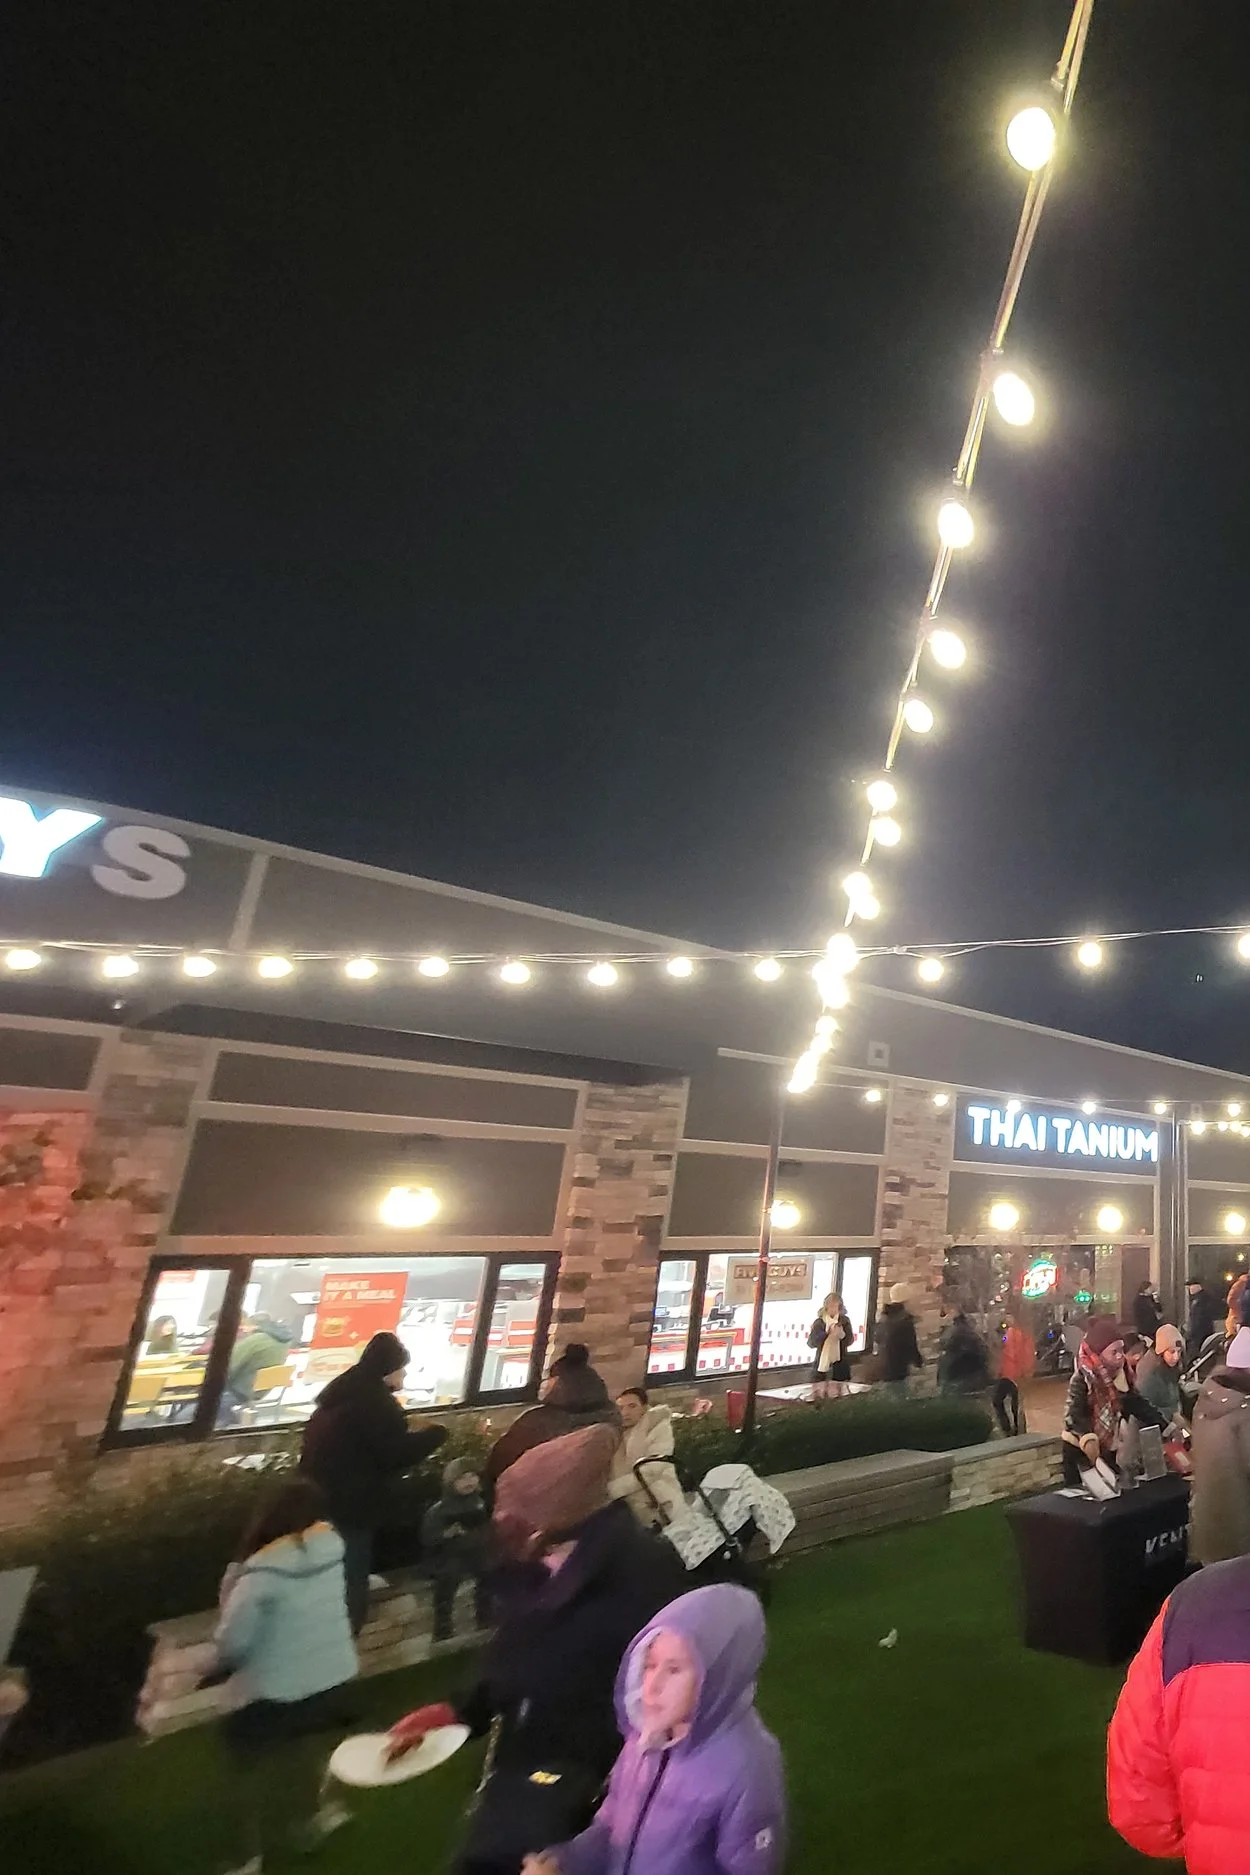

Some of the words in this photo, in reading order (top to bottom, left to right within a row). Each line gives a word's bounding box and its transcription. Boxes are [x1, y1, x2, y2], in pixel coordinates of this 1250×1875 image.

[967, 1105, 1047, 1152] THAI
[1051, 1117, 1158, 1163] TANIUM
[736, 1265, 759, 1278] FIV
